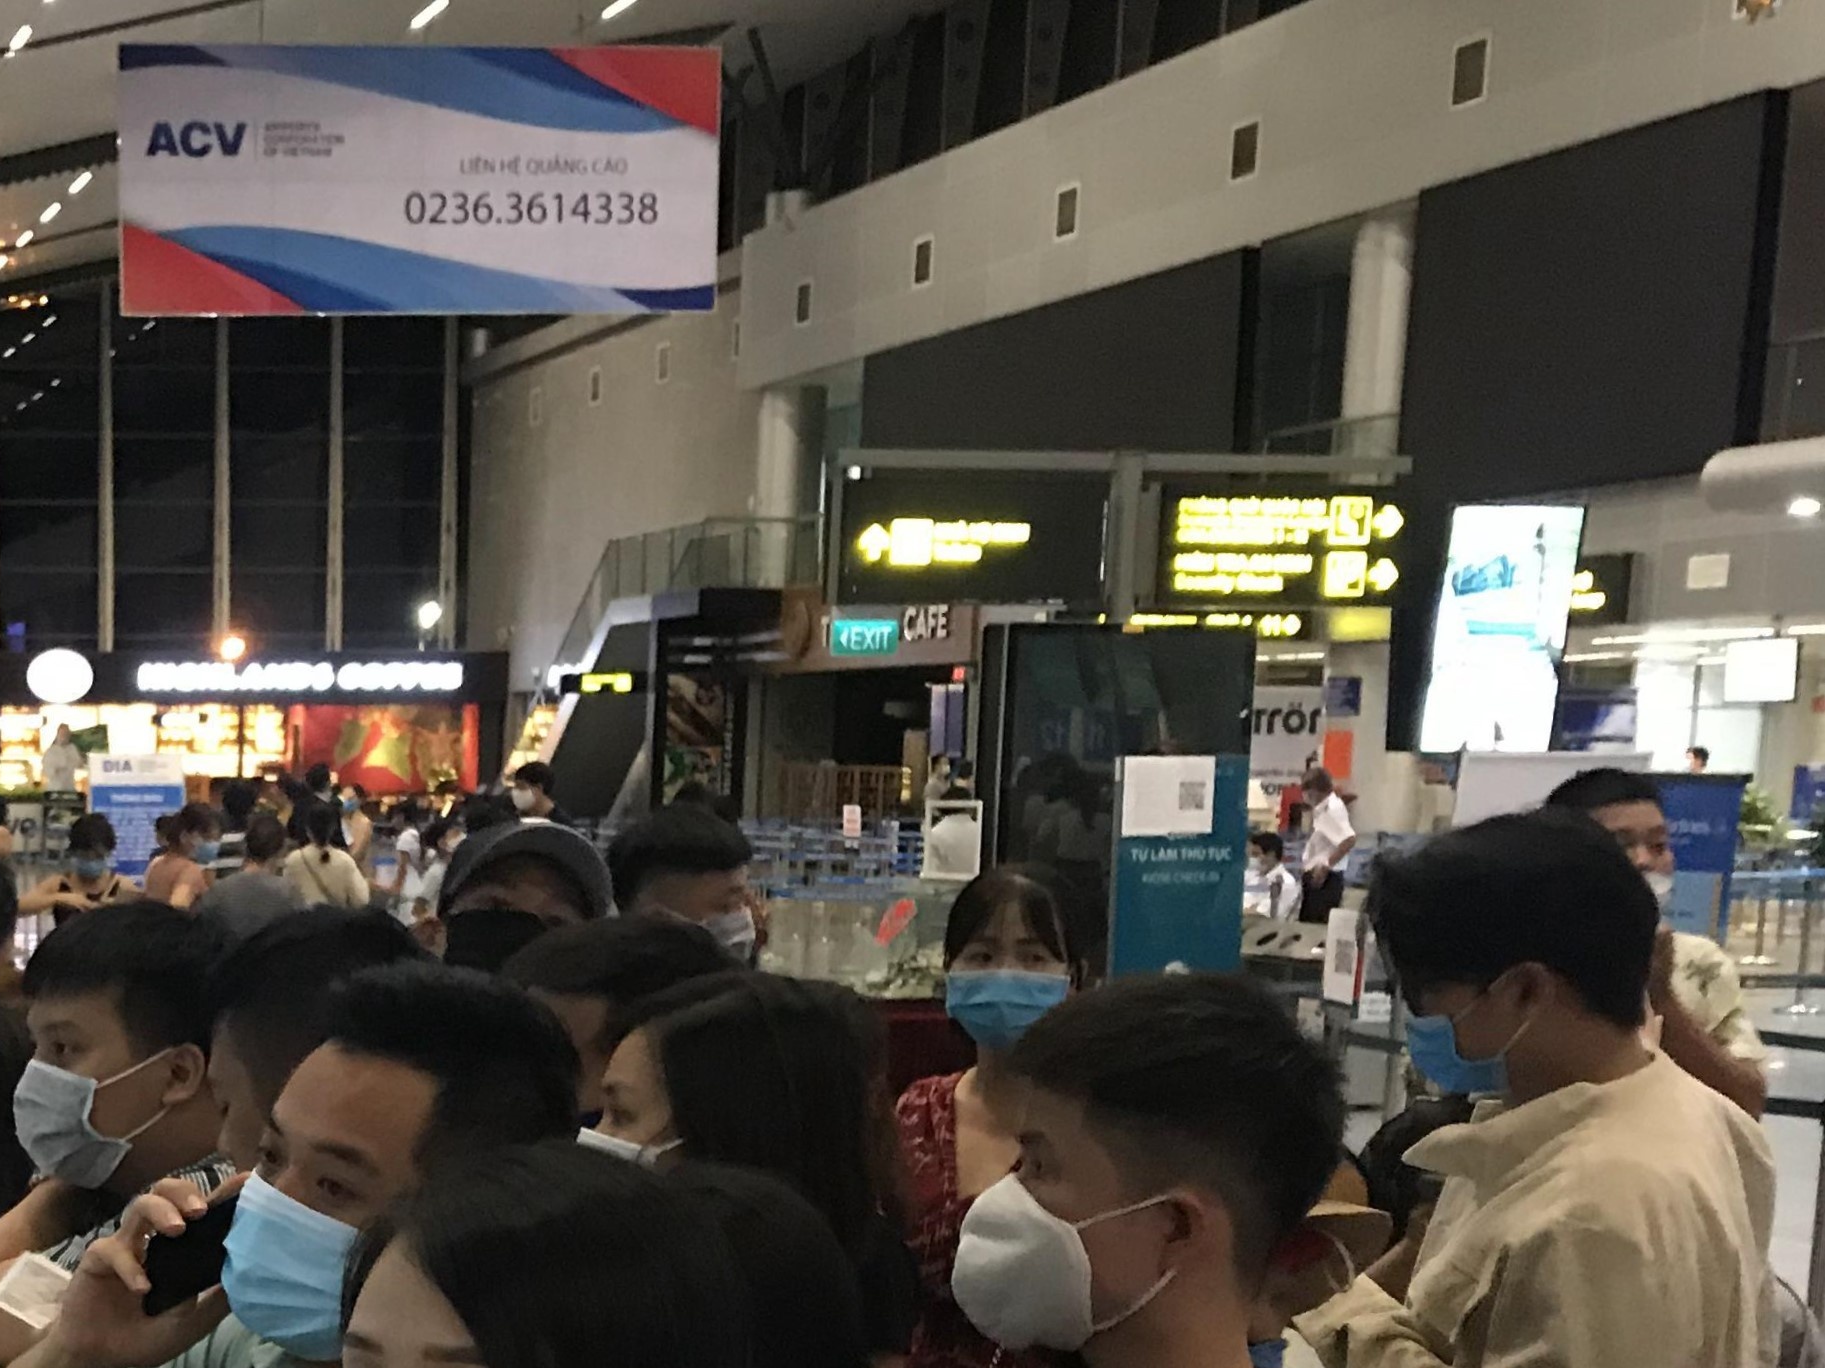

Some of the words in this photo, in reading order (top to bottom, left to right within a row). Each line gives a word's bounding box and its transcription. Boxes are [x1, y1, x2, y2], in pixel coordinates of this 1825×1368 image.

[147, 122, 247, 157] ACV
[404, 191, 659, 225] 0236.3614338
[850, 625, 893, 651] EXIT
[903, 604, 949, 641] CAFE
